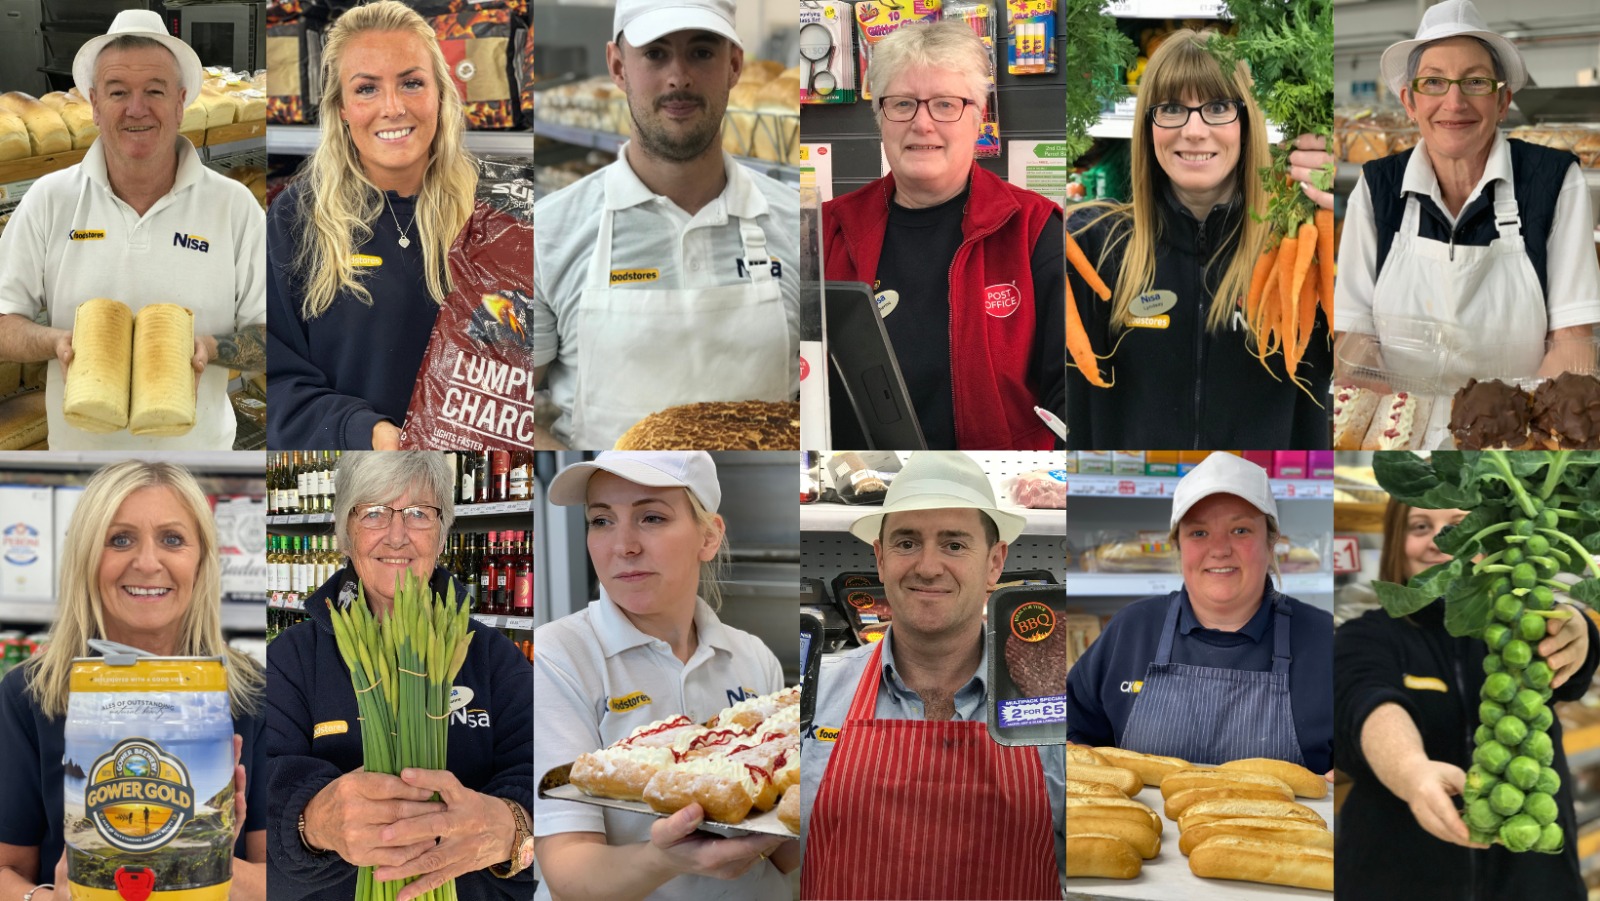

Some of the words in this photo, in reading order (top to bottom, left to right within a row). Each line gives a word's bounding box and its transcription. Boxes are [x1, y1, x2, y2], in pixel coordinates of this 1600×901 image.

[888, 11, 900, 21] 10
[173, 232, 210, 253] Nisa
[988, 289, 1011, 300] POST
[1141, 294, 1161, 304] Nisa
[985, 296, 1017, 309] OFFICE
[433, 427, 457, 442] LIGHTS
[456, 435, 484, 451] FASTER
[1017, 613, 1052, 633] BBQ
[101, 703, 116, 711] ALES
[127, 699, 175, 711] OUTSTANDING
[1005, 698, 1039, 706] MULTIPACK
[450, 706, 490, 728] Nsa
[1012, 708, 1022, 718] 2
[1042, 704, 1065, 716] £5
[116, 750, 133, 772] GOWER
[134, 748, 158, 772] BREWERY
[87, 781, 145, 808] GOWER
[144, 782, 191, 808] GOLD
